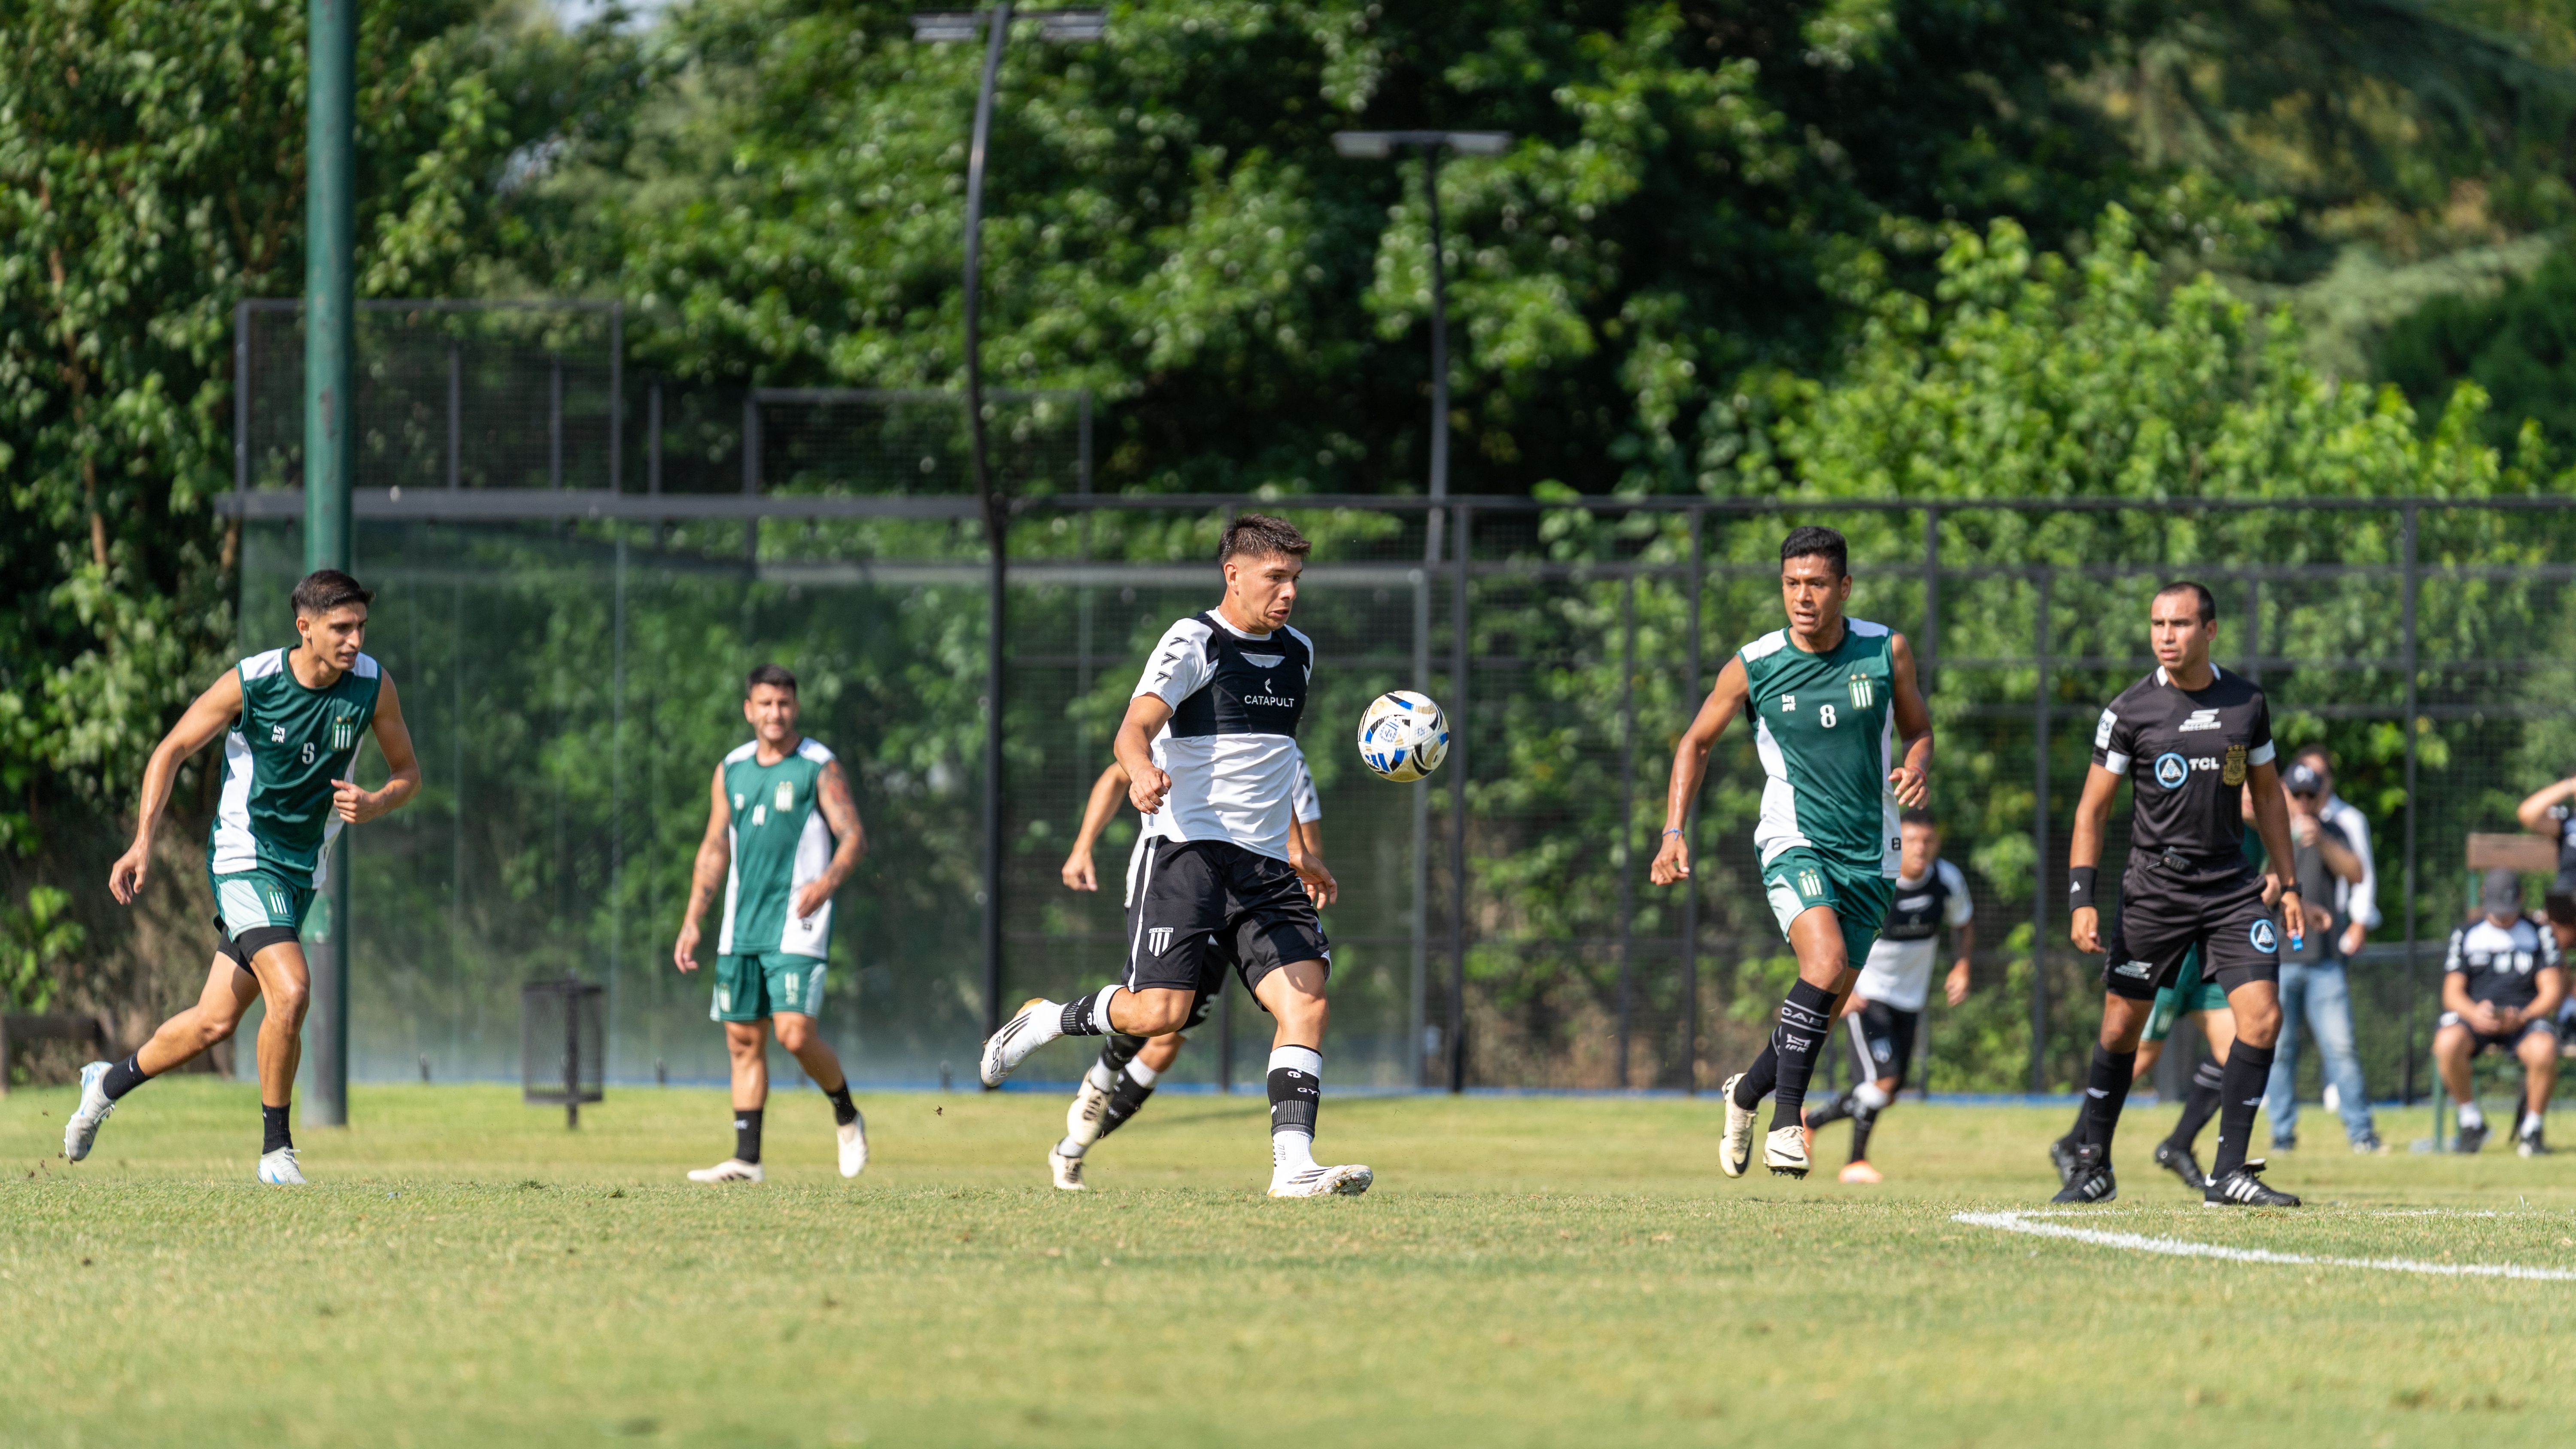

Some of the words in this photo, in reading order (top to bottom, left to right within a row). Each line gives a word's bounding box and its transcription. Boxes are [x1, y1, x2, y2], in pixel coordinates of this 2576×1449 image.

[1244, 695, 1294, 707] CATAPULT
[1820, 704, 1836, 728] 8
[302, 742, 315, 764] 5
[2188, 757, 2220, 771] TCL
[990, 1036, 1001, 1074] F50
